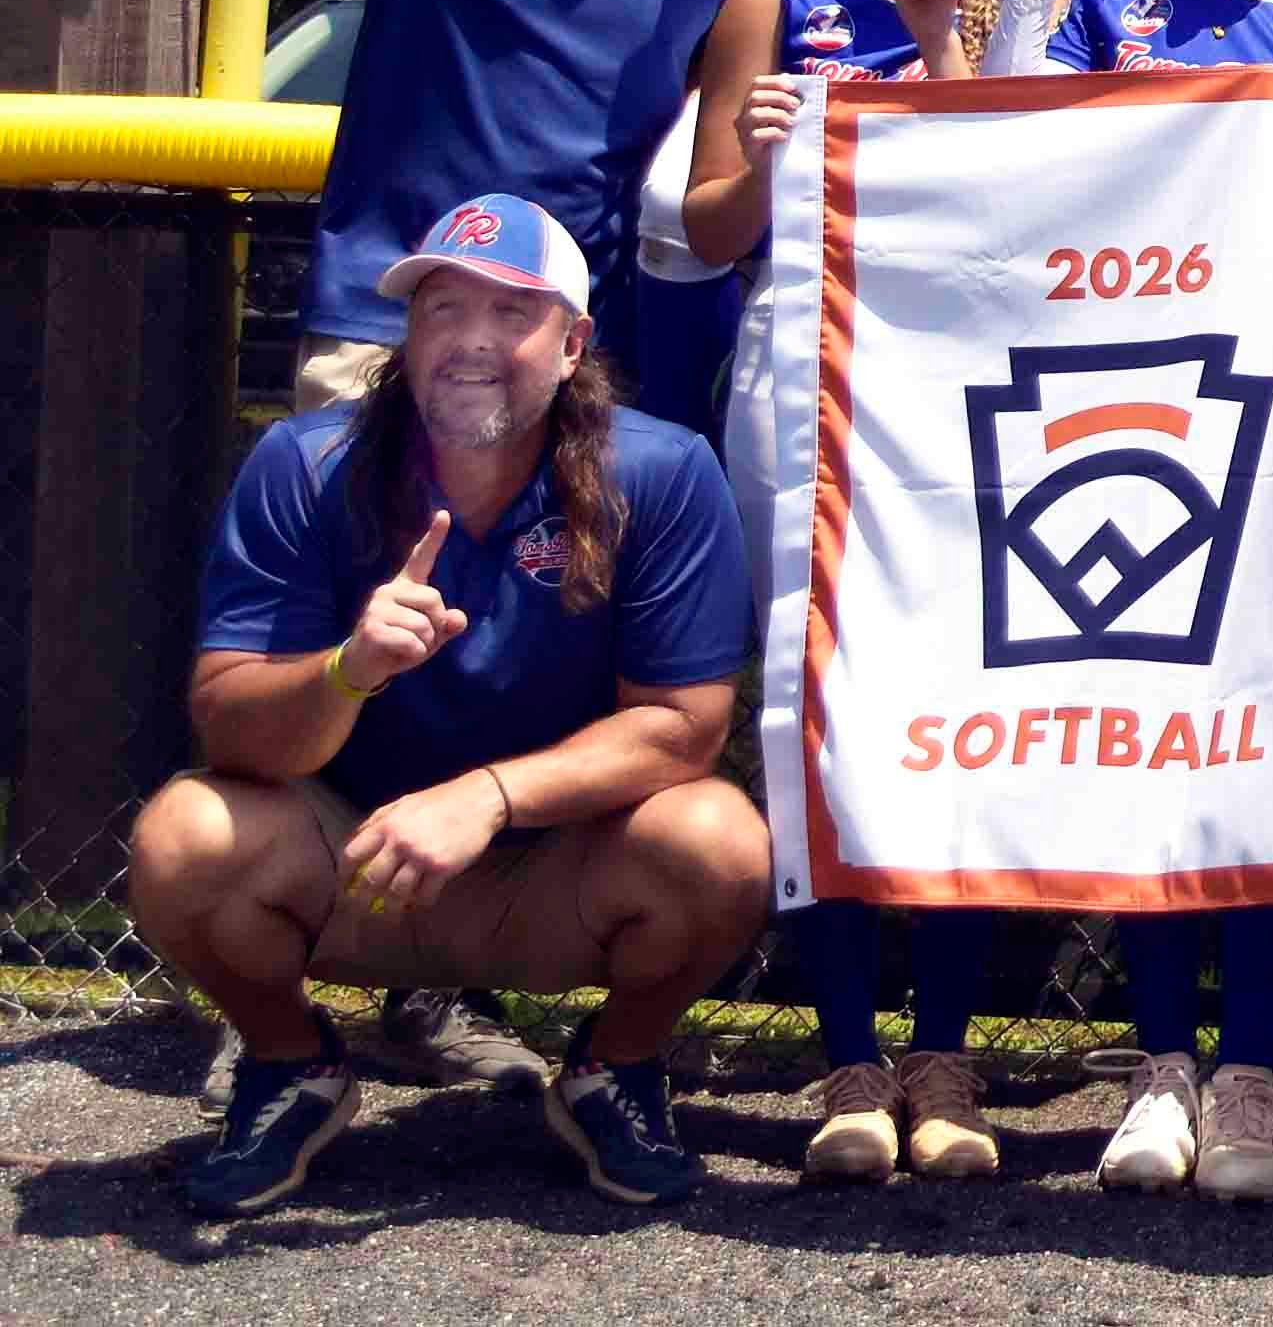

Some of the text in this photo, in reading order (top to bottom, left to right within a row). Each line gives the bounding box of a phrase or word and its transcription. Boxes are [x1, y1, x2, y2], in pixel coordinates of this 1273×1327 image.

[440, 204, 502, 247] TR
[1046, 243, 1214, 300] 2026
[900, 704, 1265, 772] SOFTBALL
